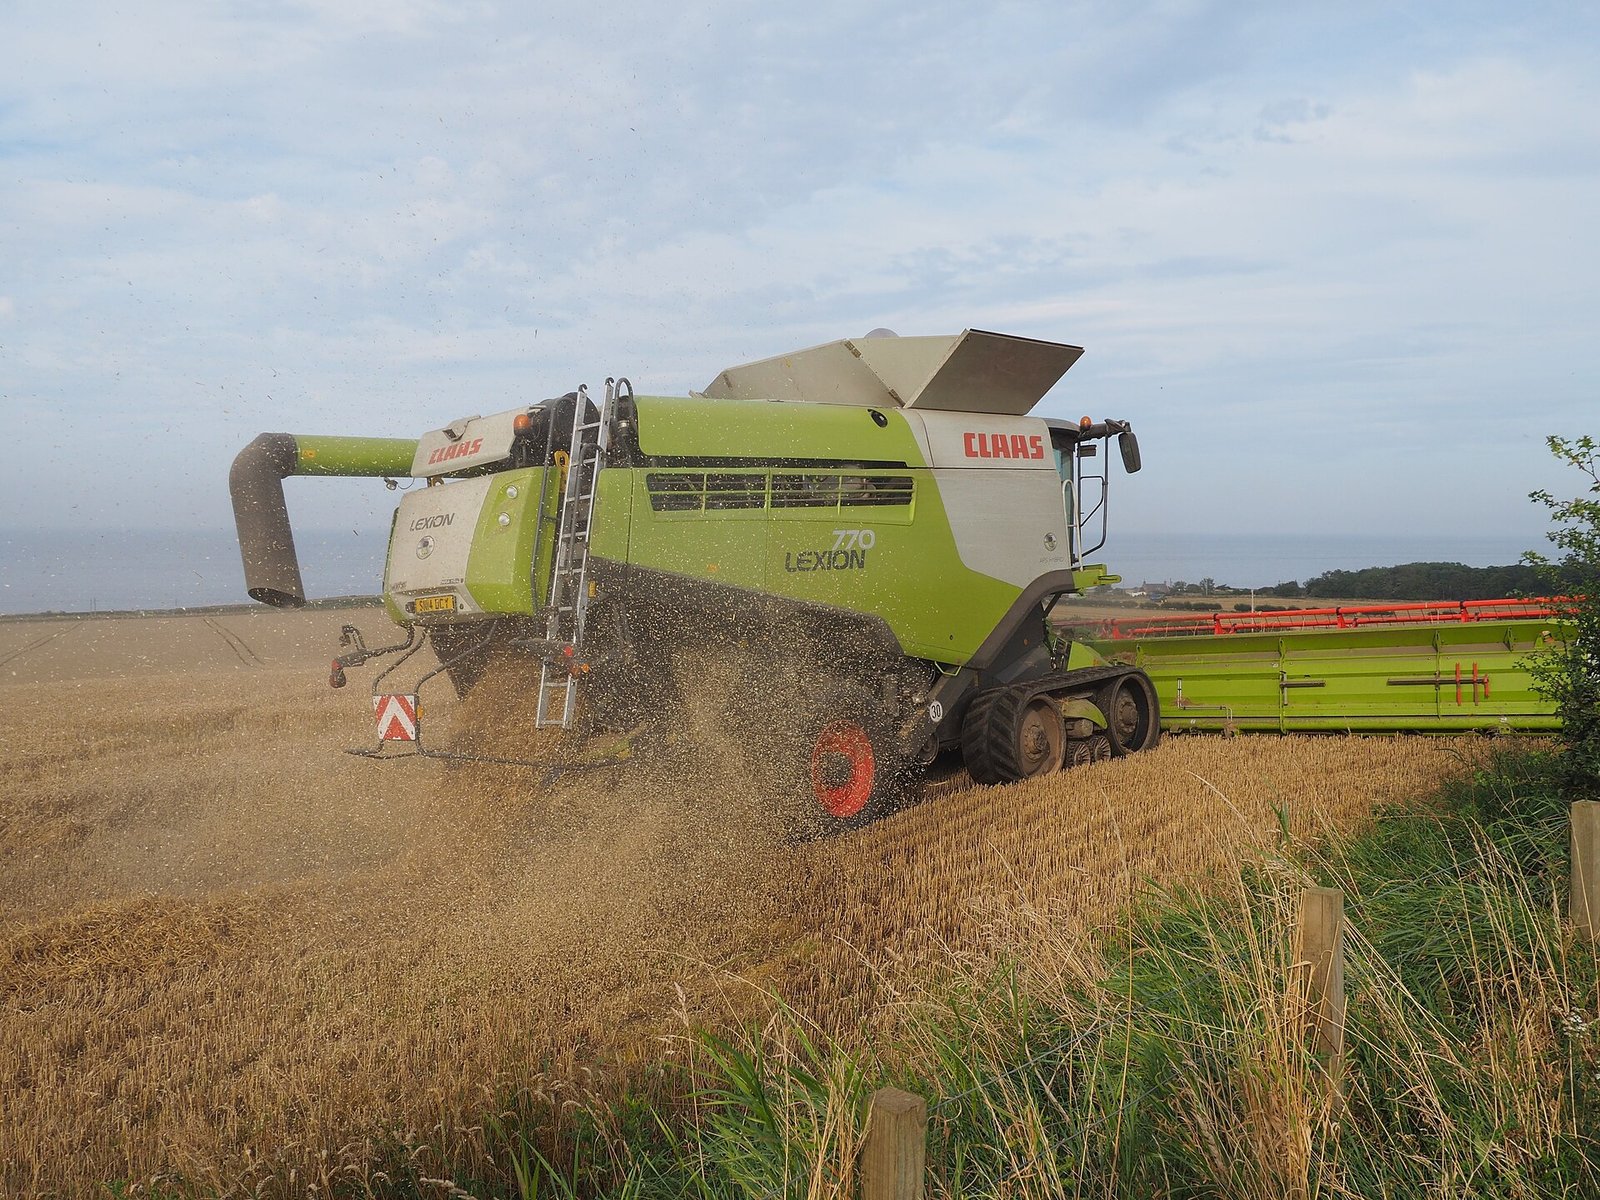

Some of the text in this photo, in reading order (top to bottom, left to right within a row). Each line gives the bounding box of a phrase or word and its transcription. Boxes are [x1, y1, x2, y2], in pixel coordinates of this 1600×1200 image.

[428, 437, 484, 465] CLAAS
[963, 432, 1044, 459] CLAAS
[409, 512, 456, 531] LEXION
[831, 529, 876, 551] 770
[784, 549, 866, 572] LEXION
[931, 704, 941, 719] 30
